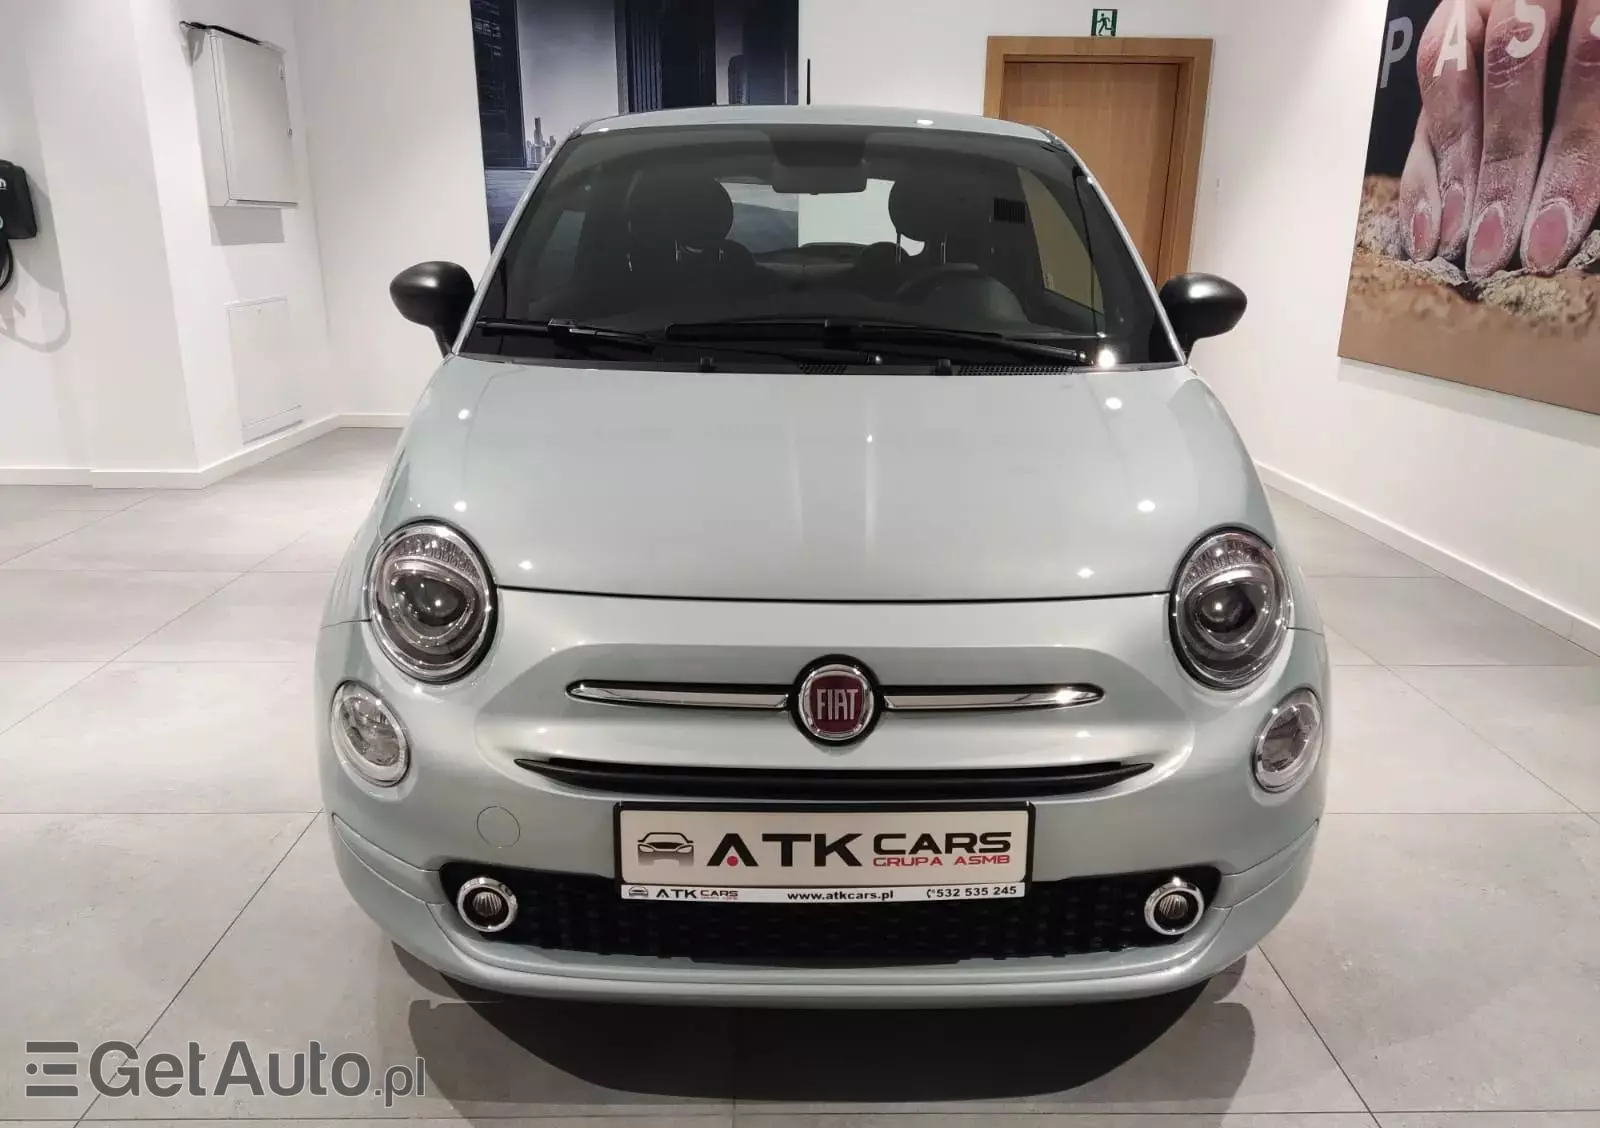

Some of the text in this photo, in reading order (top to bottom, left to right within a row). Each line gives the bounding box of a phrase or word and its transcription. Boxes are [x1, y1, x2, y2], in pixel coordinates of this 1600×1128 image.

[816, 688, 859, 721] FIAT
[706, 832, 1012, 867] ATK CARS
[873, 854, 1011, 867] GRUPA ASMB
[656, 888, 697, 899] ATK
[700, 889, 739, 897] CARS
[787, 890, 894, 901] www.atkcars.pl
[936, 885, 1017, 898] 532 535 245
